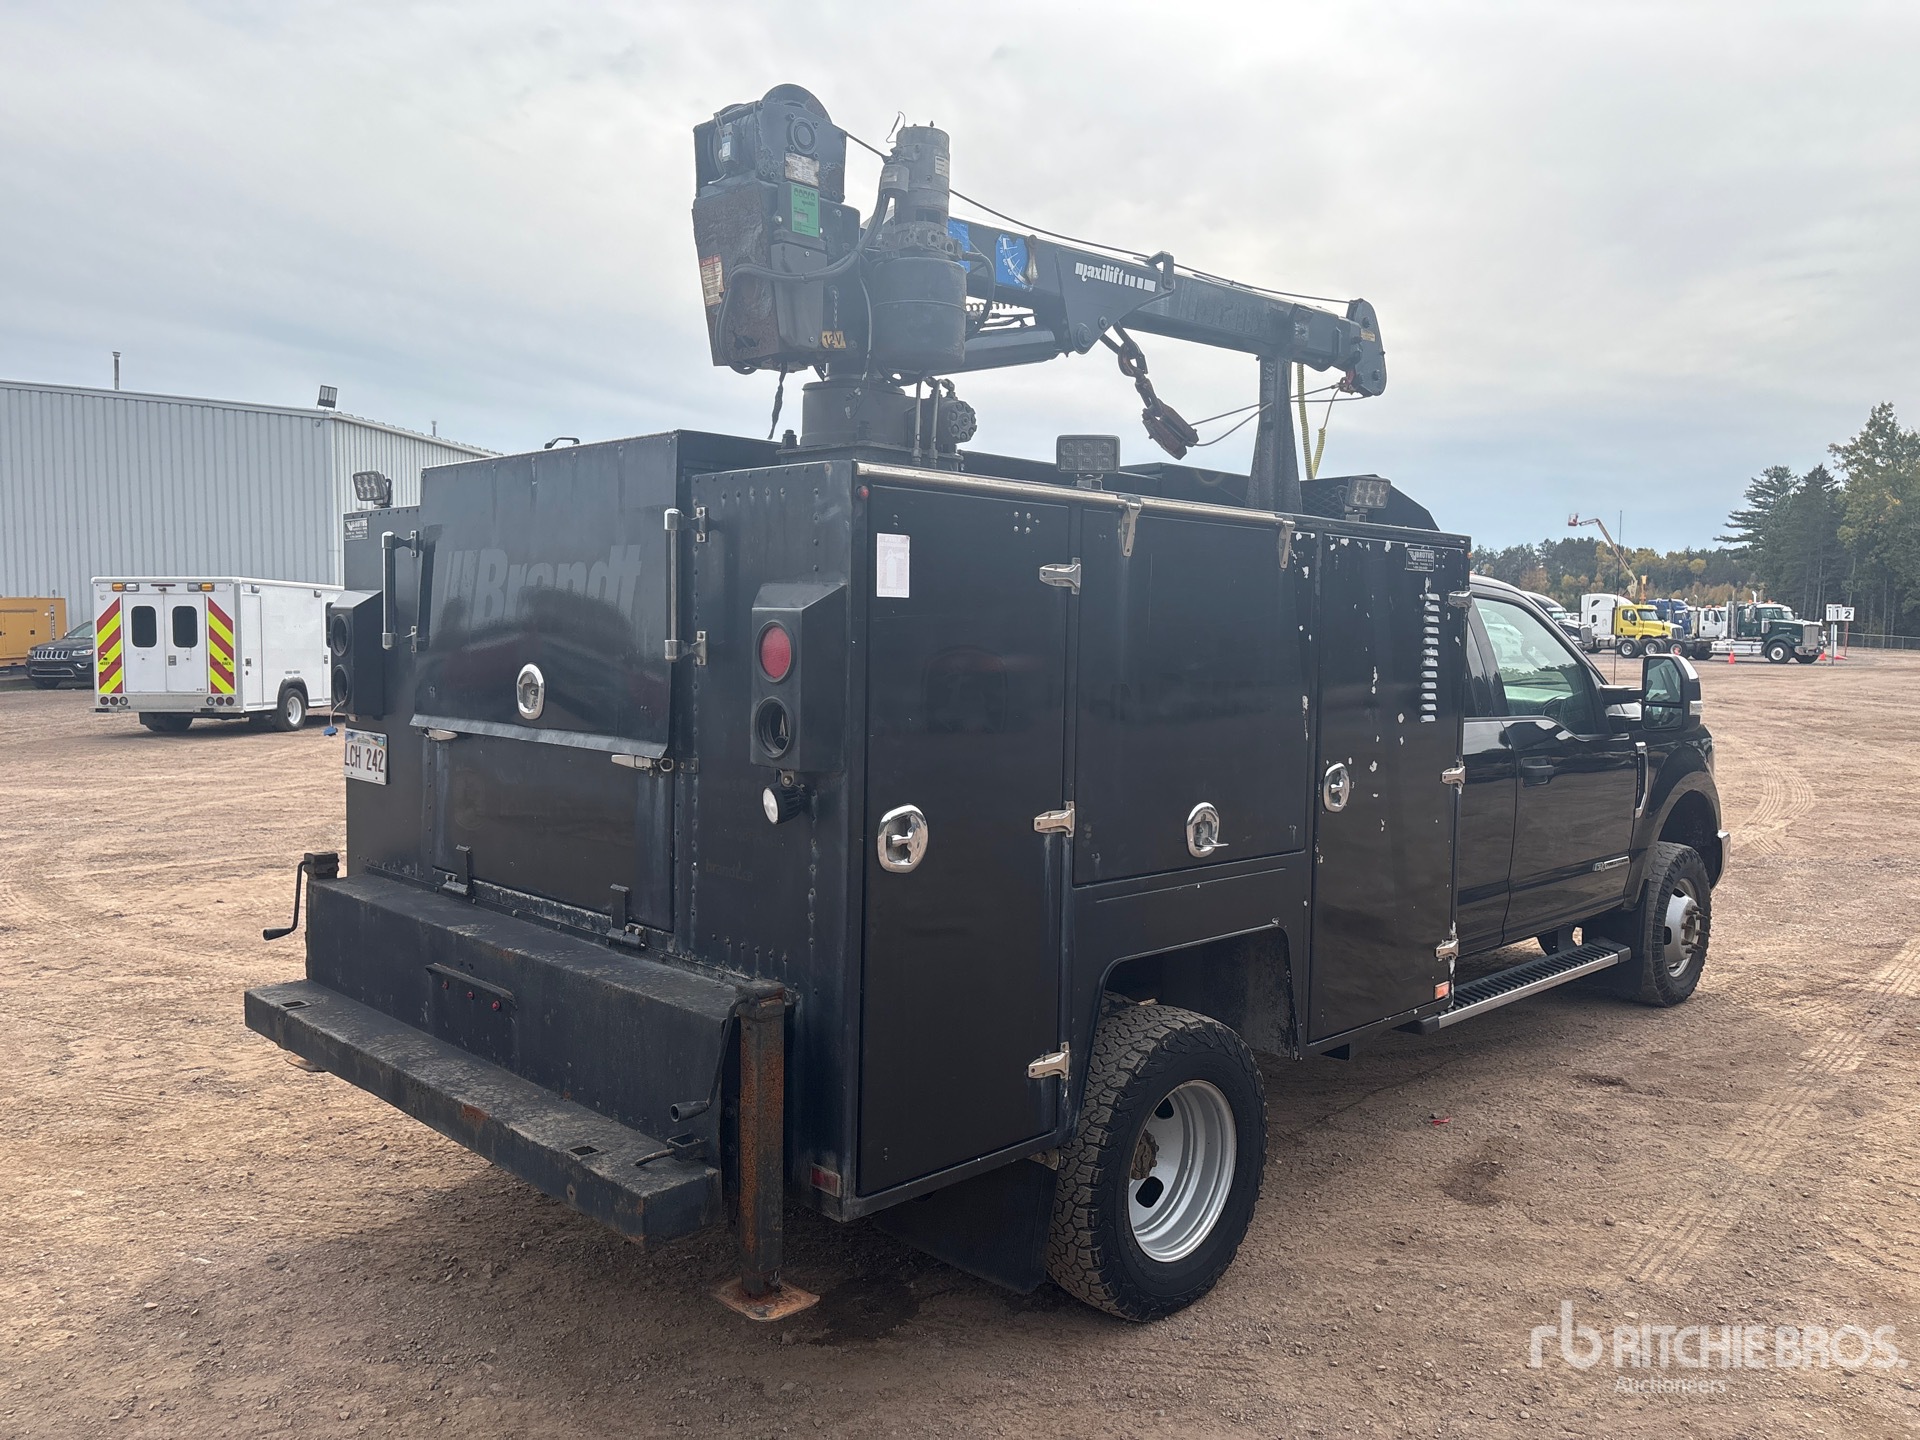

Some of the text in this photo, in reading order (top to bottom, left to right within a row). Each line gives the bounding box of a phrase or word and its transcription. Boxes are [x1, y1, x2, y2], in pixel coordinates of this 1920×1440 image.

[1075, 262, 1124, 285] maxilift
[1843, 611, 1851, 620] 2
[345, 742, 384, 773] LCH 242
